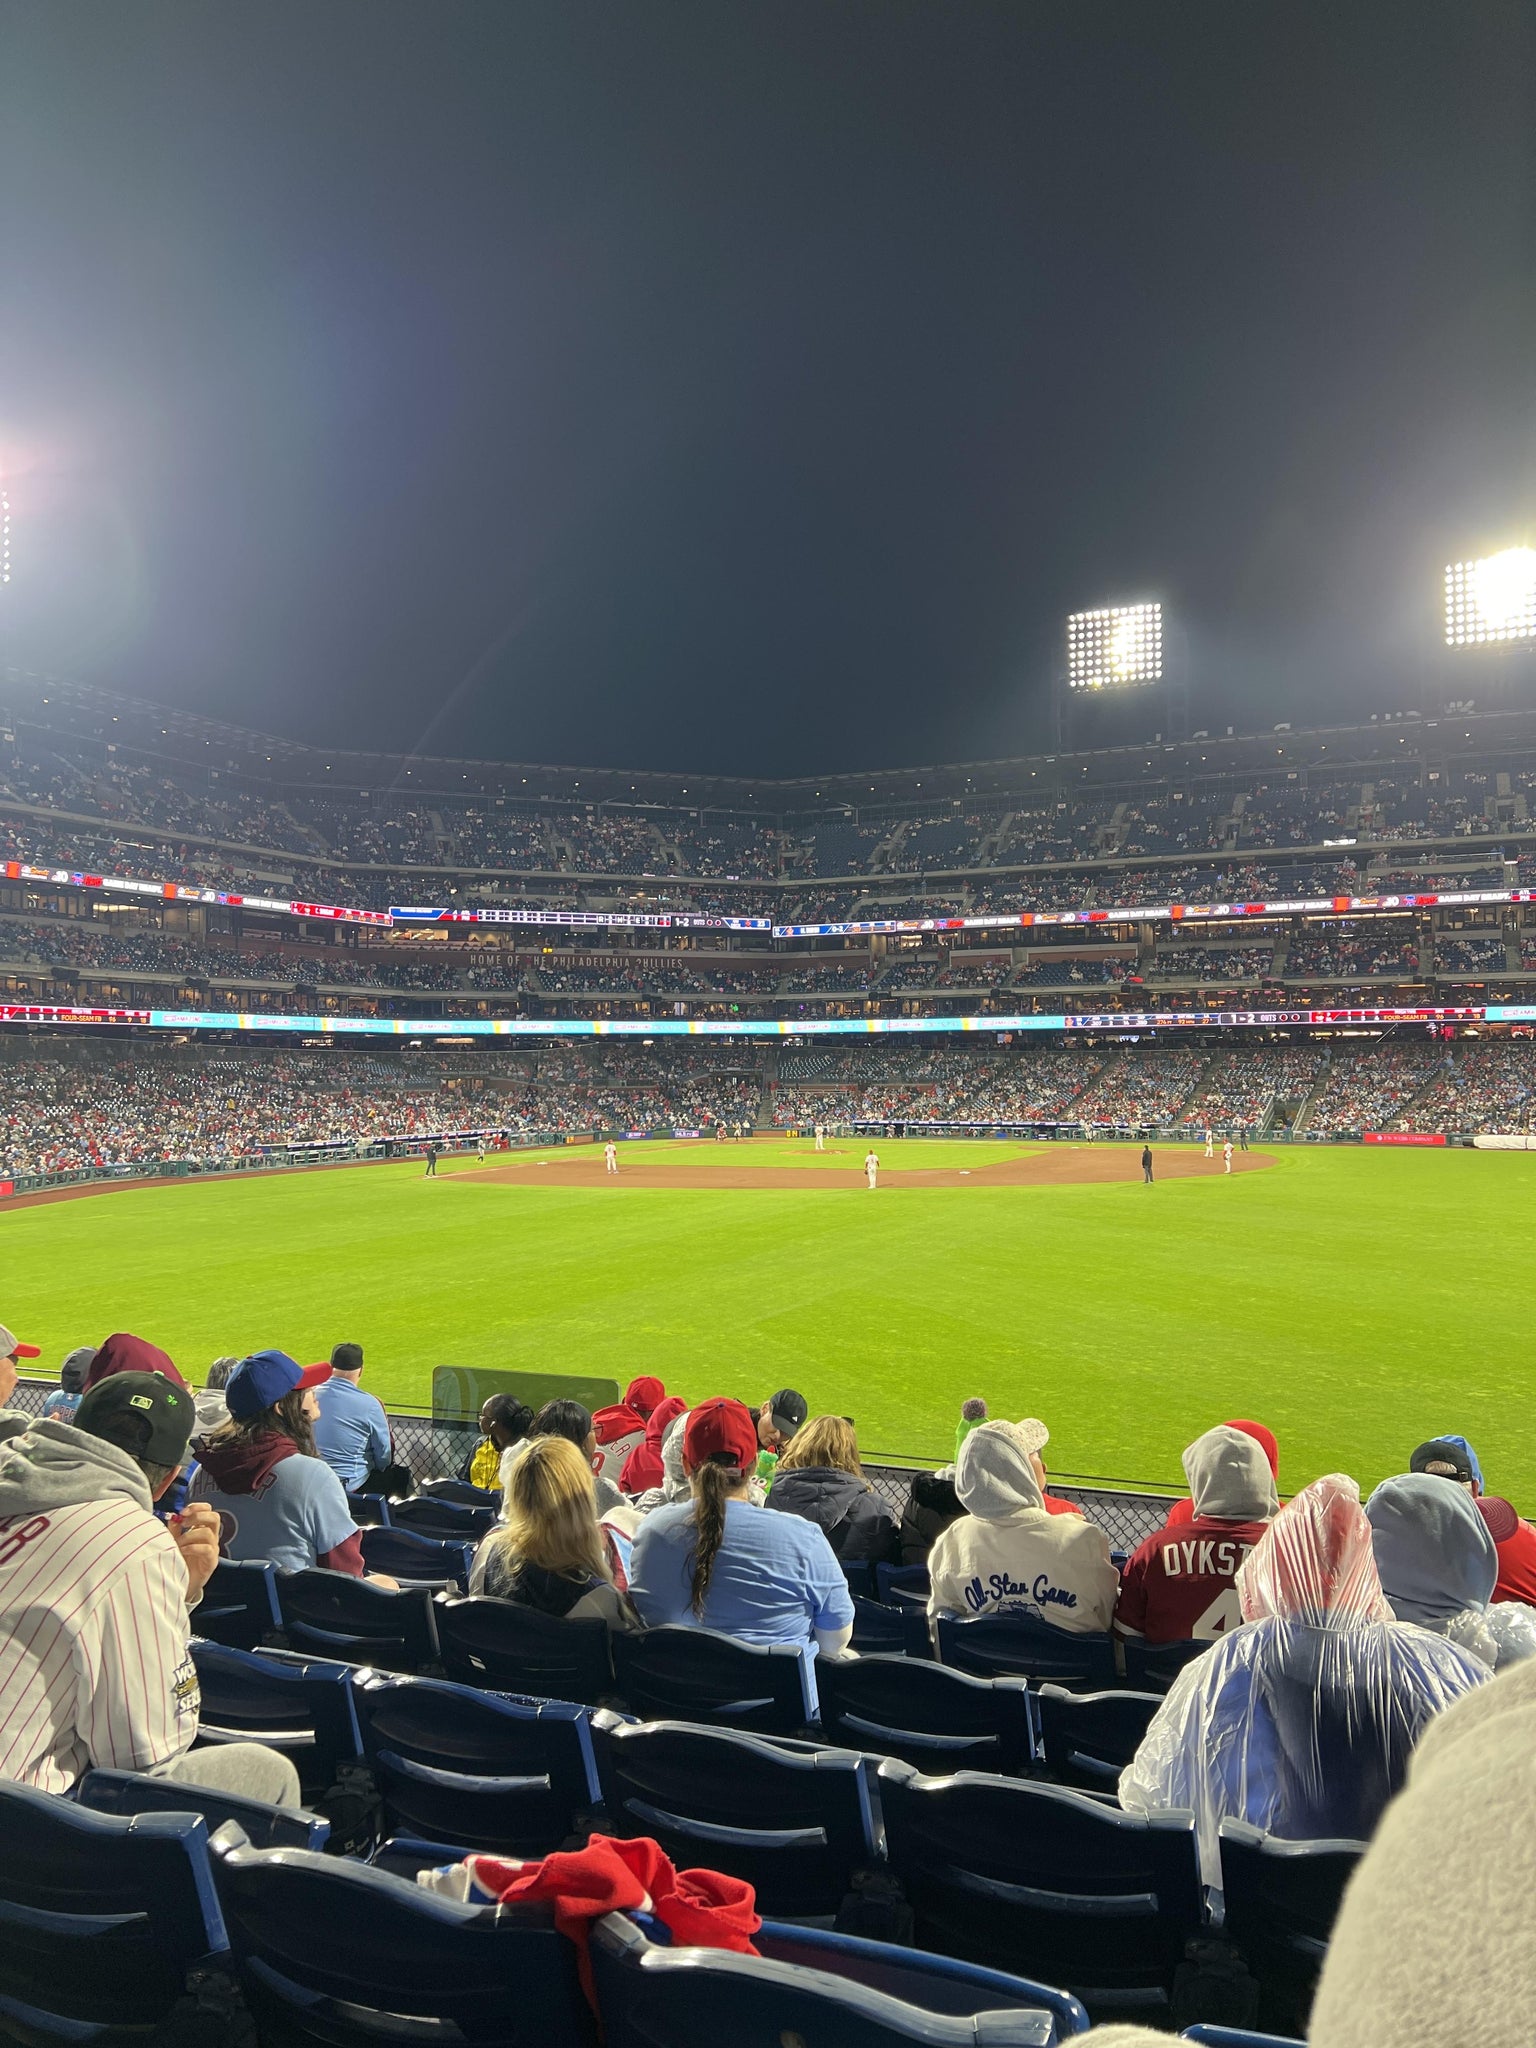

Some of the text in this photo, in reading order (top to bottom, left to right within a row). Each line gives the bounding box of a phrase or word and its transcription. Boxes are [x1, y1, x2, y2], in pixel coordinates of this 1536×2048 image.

[470, 954, 501, 966] HOME
[507, 954, 520, 966] OF
[553, 956, 630, 968] PHILADELPHIA
[61, 1014, 94, 1022] FOUR-SEAM
[1260, 1014, 1277, 1022] OUTS
[1163, 1540, 1256, 1577] DYKST
[964, 1572, 1078, 1612] All-Star Game
